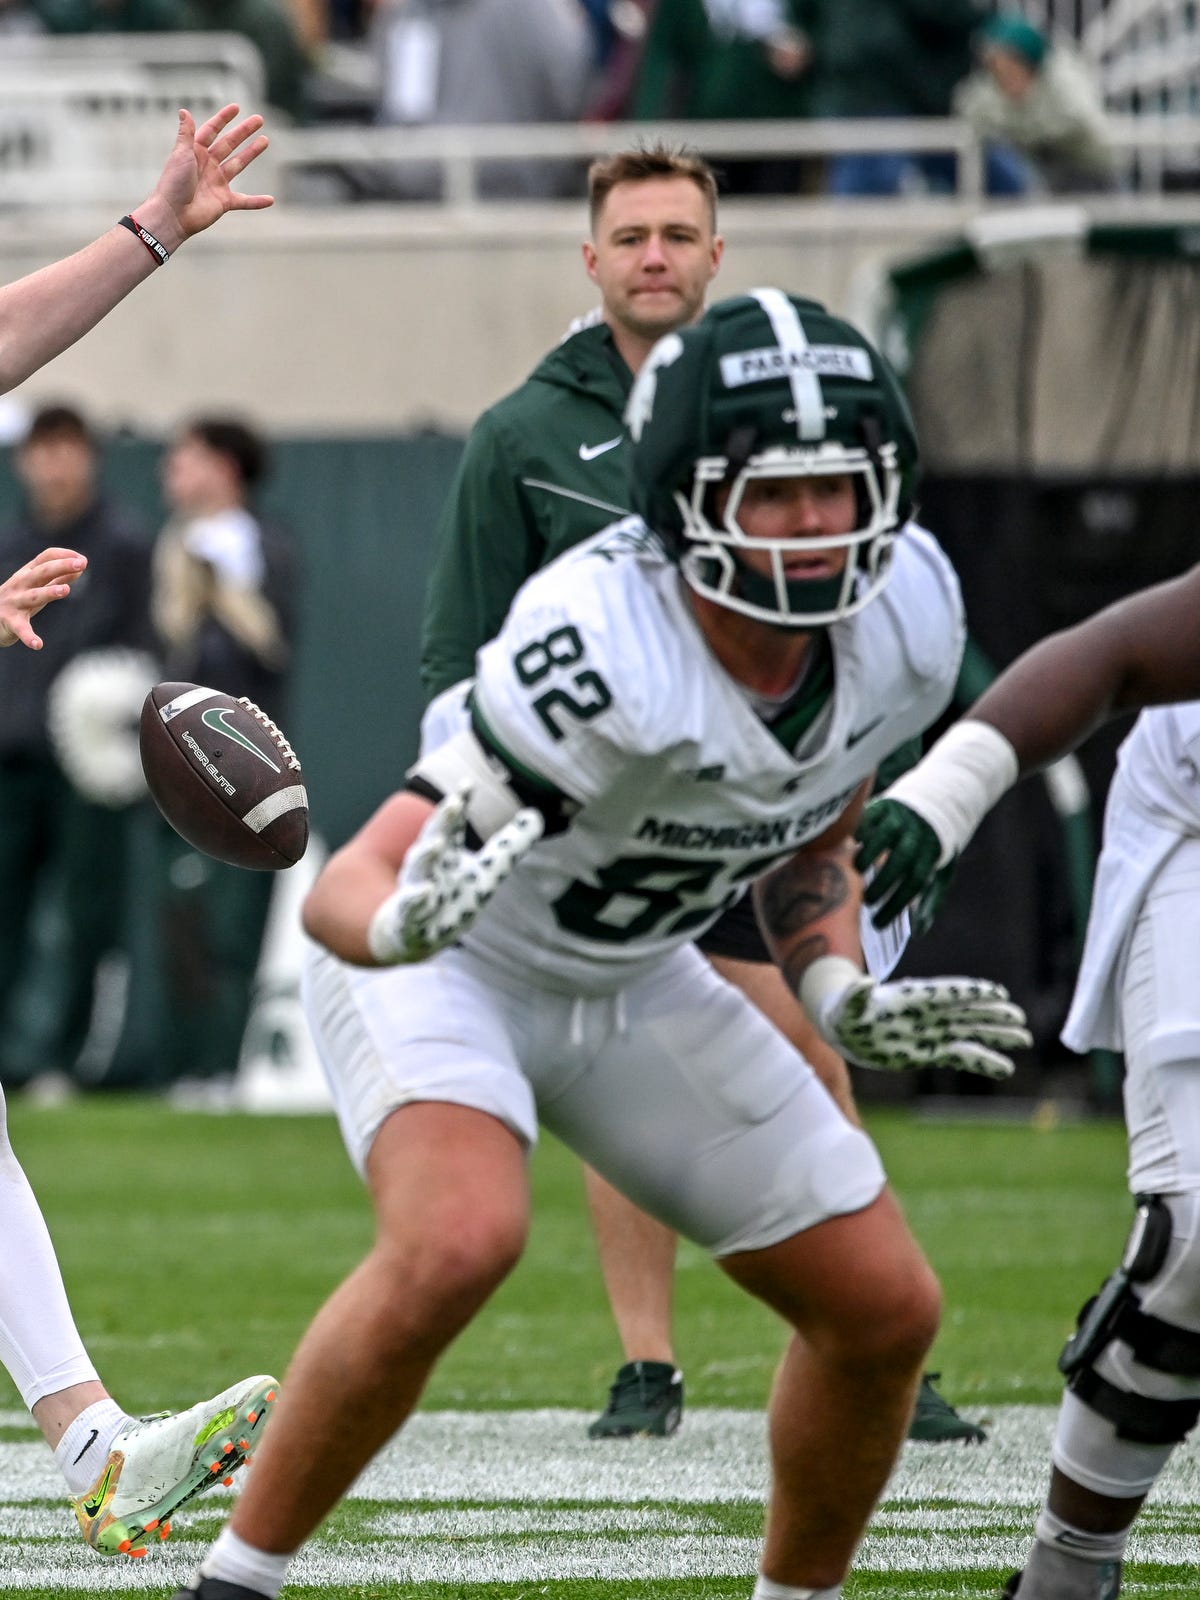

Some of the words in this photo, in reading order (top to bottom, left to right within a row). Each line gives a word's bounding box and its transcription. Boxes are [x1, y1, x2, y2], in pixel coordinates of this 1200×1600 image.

[513, 625, 612, 741] 82
[182, 731, 209, 769] VAPOR
[206, 763, 237, 796] ELITE
[634, 816, 789, 851] MICHIGAN
